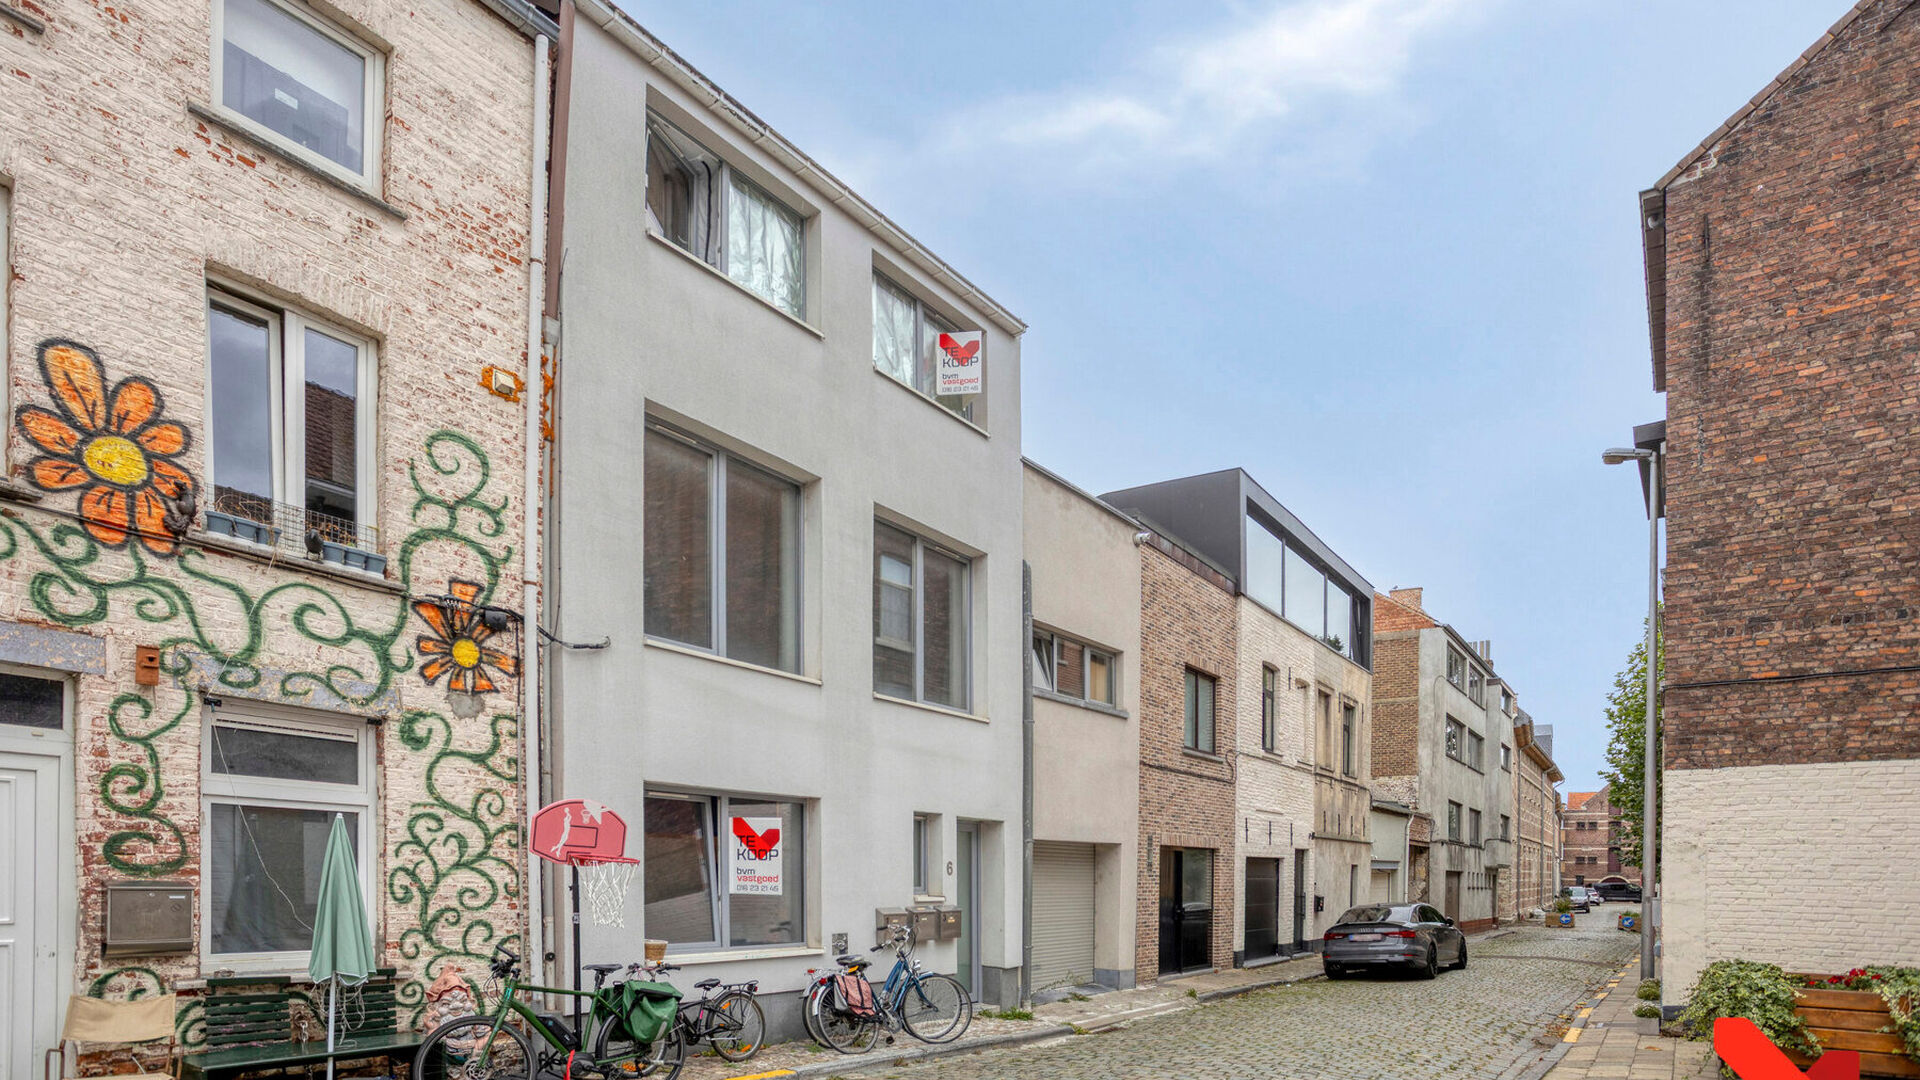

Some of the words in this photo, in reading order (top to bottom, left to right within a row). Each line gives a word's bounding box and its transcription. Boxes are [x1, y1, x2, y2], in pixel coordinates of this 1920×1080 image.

[943, 346, 959, 357] TE
[942, 357, 979, 368] KOOP
[942, 378, 979, 386] vastgoed
[736, 835, 756, 848] TE
[737, 848, 779, 861] KOOP
[736, 867, 756, 875] bvm
[946, 861, 953, 876] 6
[737, 875, 779, 884] vastgoed
